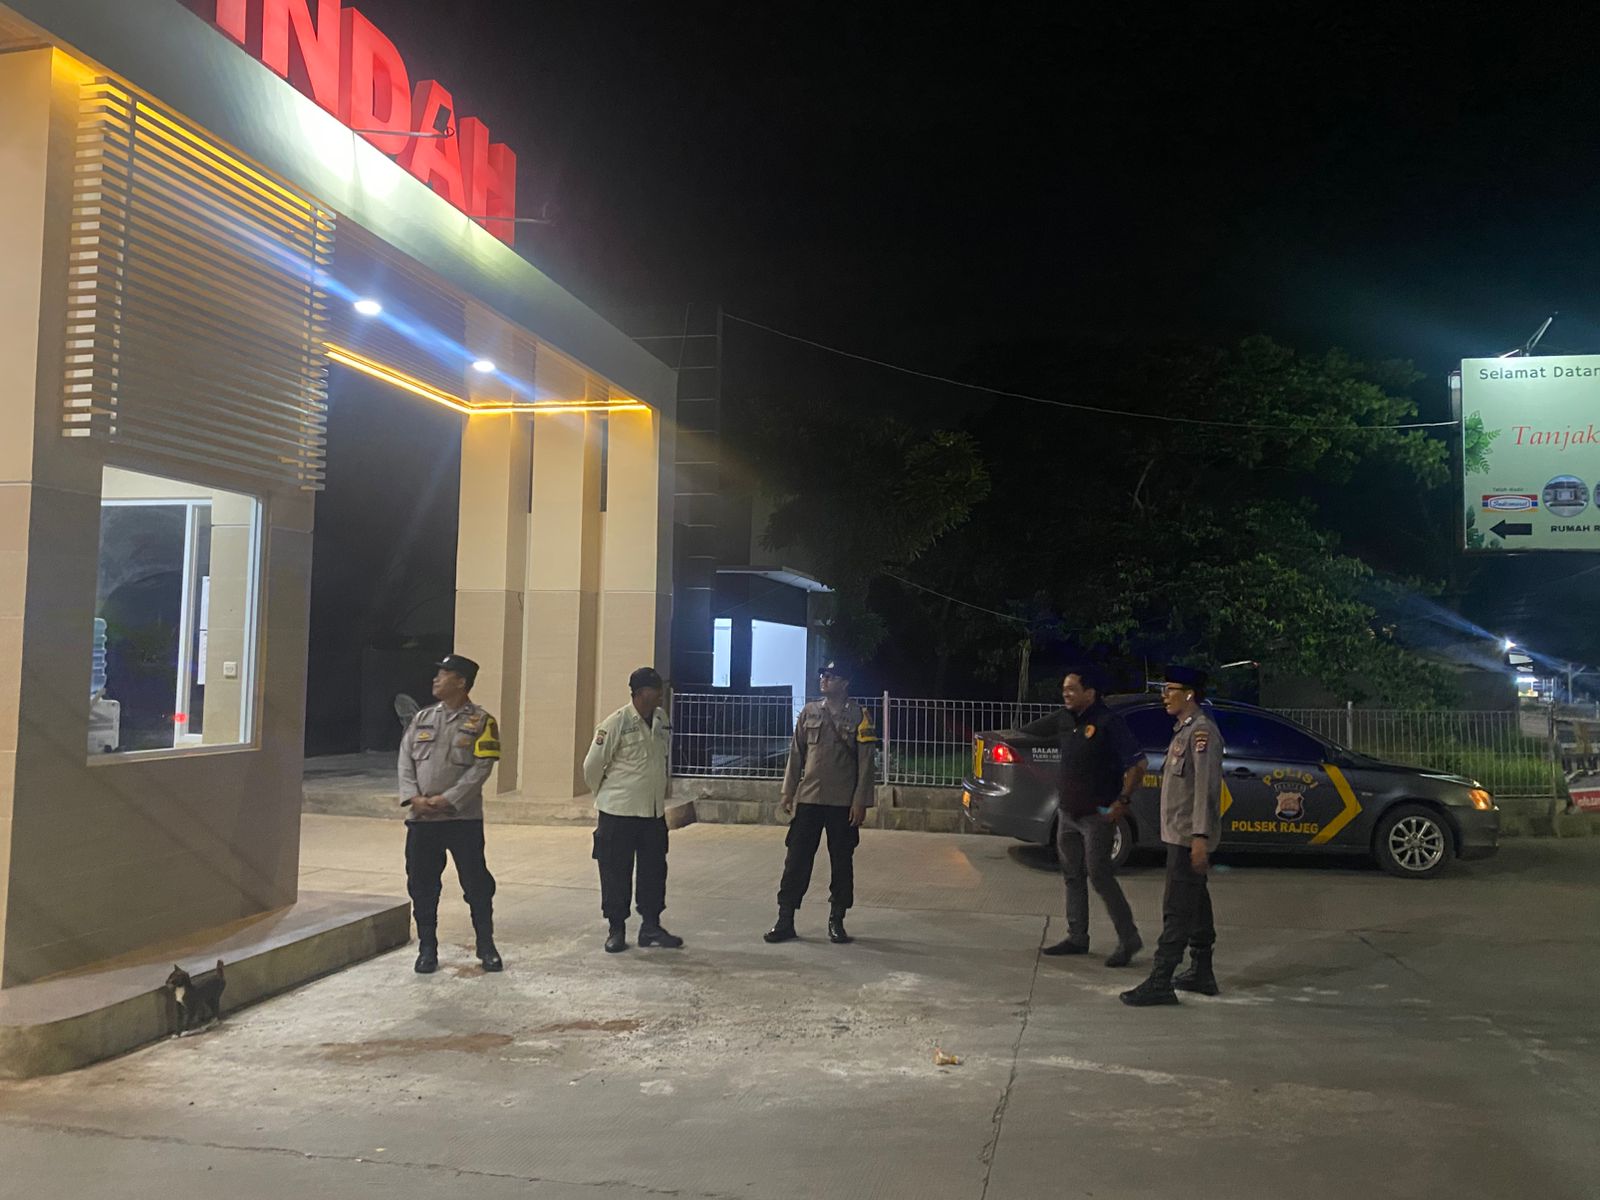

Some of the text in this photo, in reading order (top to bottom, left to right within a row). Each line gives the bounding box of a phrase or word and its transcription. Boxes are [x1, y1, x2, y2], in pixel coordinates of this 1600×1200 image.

[212, 0, 516, 248] NDAH
[1480, 367, 1546, 380] Selamat
[1512, 424, 1600, 451] Tanjak
[1231, 820, 1319, 834] POLSEK RAJEG
